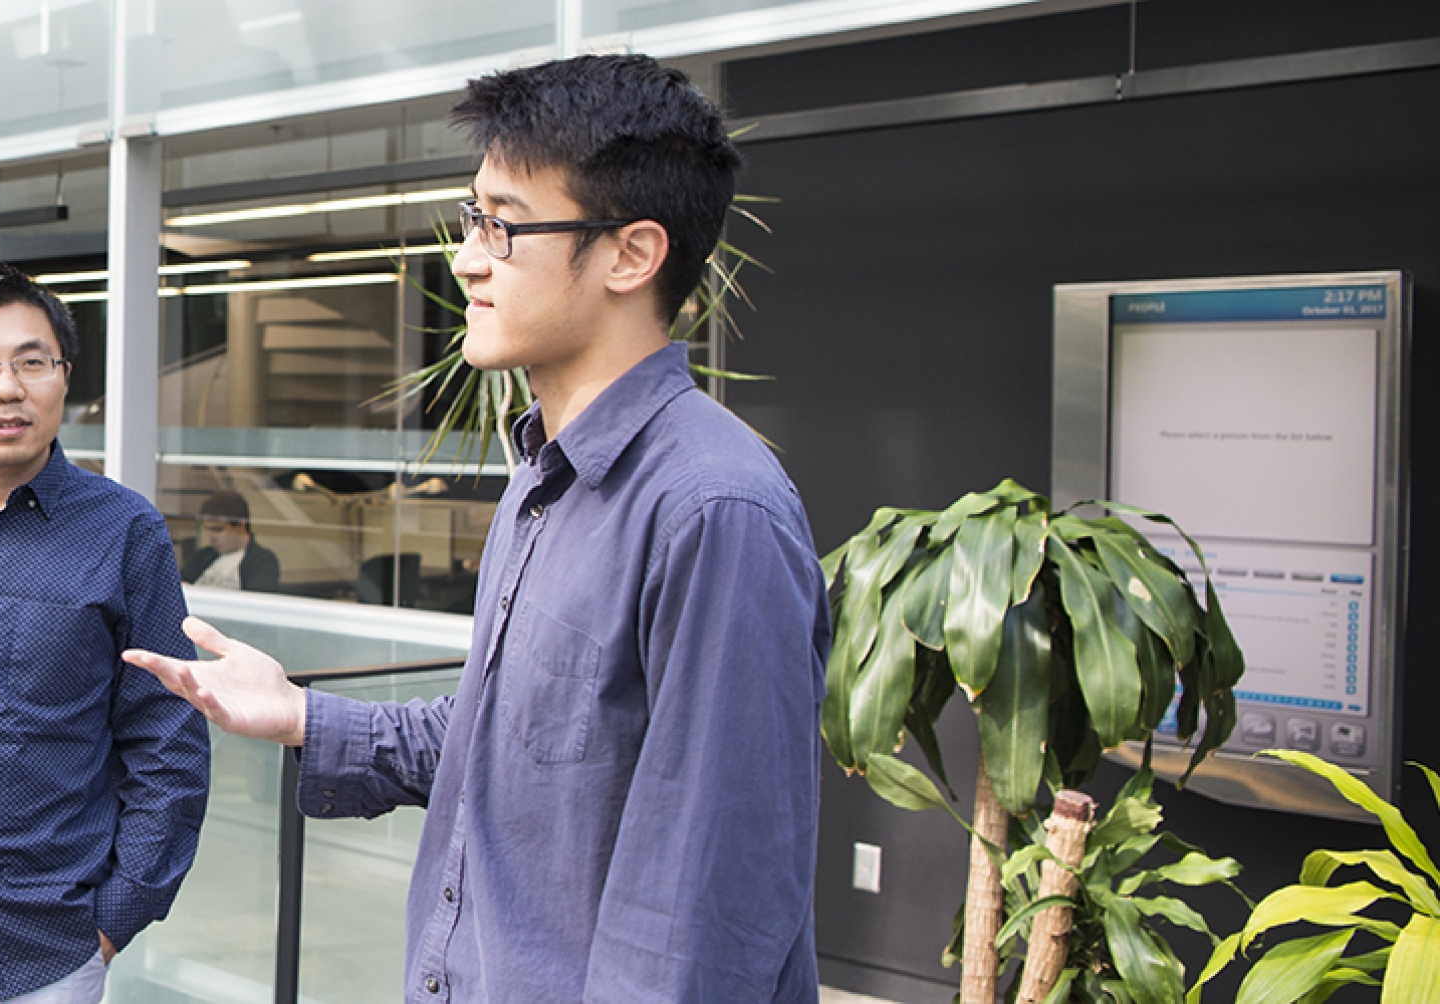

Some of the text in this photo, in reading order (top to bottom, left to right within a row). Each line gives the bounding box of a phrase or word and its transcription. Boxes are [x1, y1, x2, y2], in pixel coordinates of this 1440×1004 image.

[1324, 288, 1382, 303] 2:17 PM
[1302, 305, 1340, 316] October
[1160, 429, 1185, 439] Please
[1188, 430, 1211, 439] select
[1220, 432, 1247, 441] person
[1251, 431, 1272, 440] from
[1275, 431, 1288, 440] the
